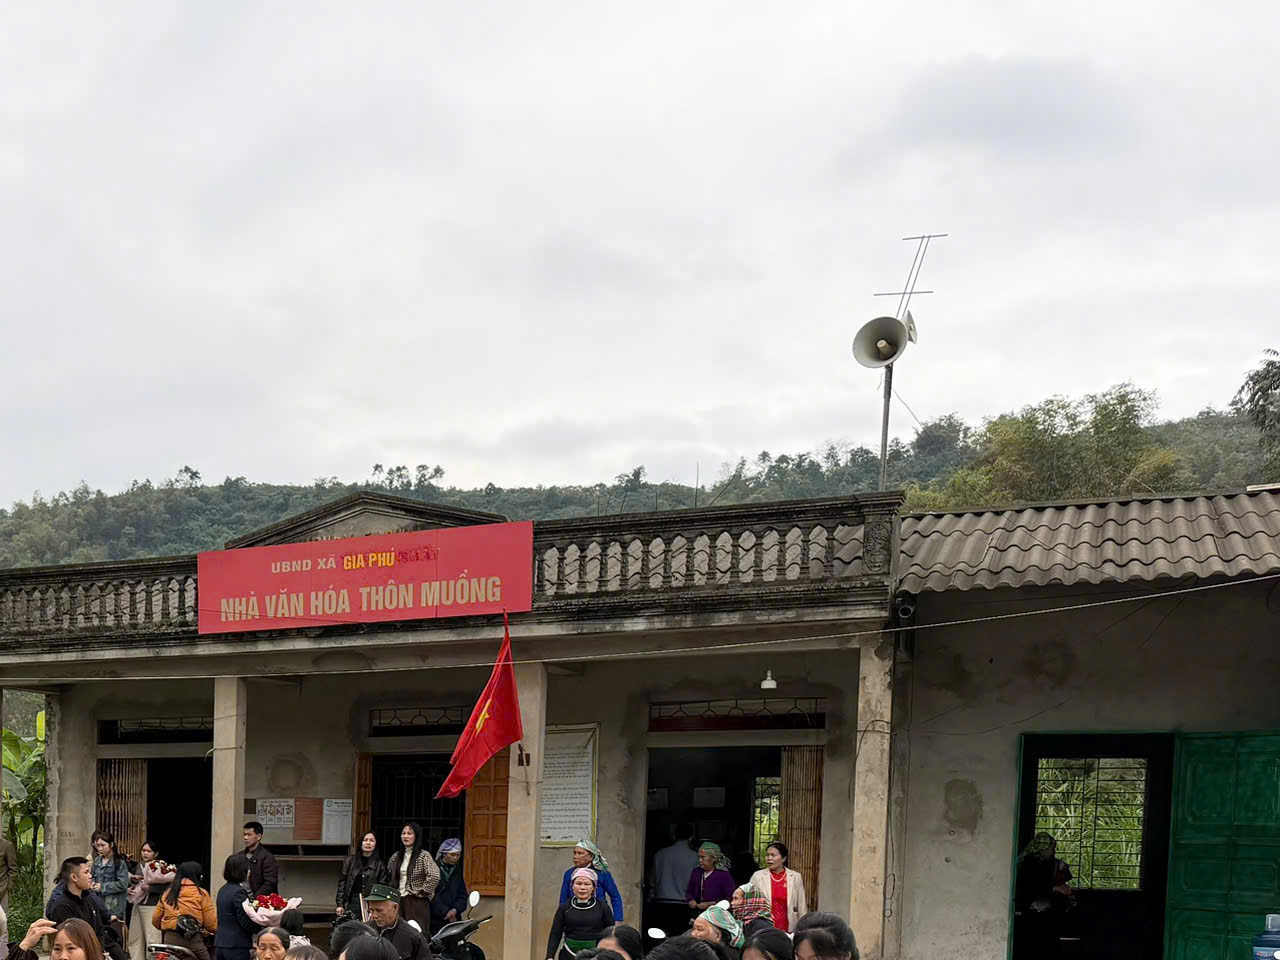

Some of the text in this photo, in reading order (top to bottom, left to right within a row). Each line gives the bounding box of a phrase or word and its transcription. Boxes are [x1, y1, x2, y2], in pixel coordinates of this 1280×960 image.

[271, 560, 312, 574] UBND
[317, 553, 337, 569] XÃ
[343, 553, 365, 570] GIA
[220, 591, 260, 622] NHÀ
[264, 587, 305, 618] VĂN
[310, 584, 351, 616] HÓA
[359, 579, 414, 612] THÔN
